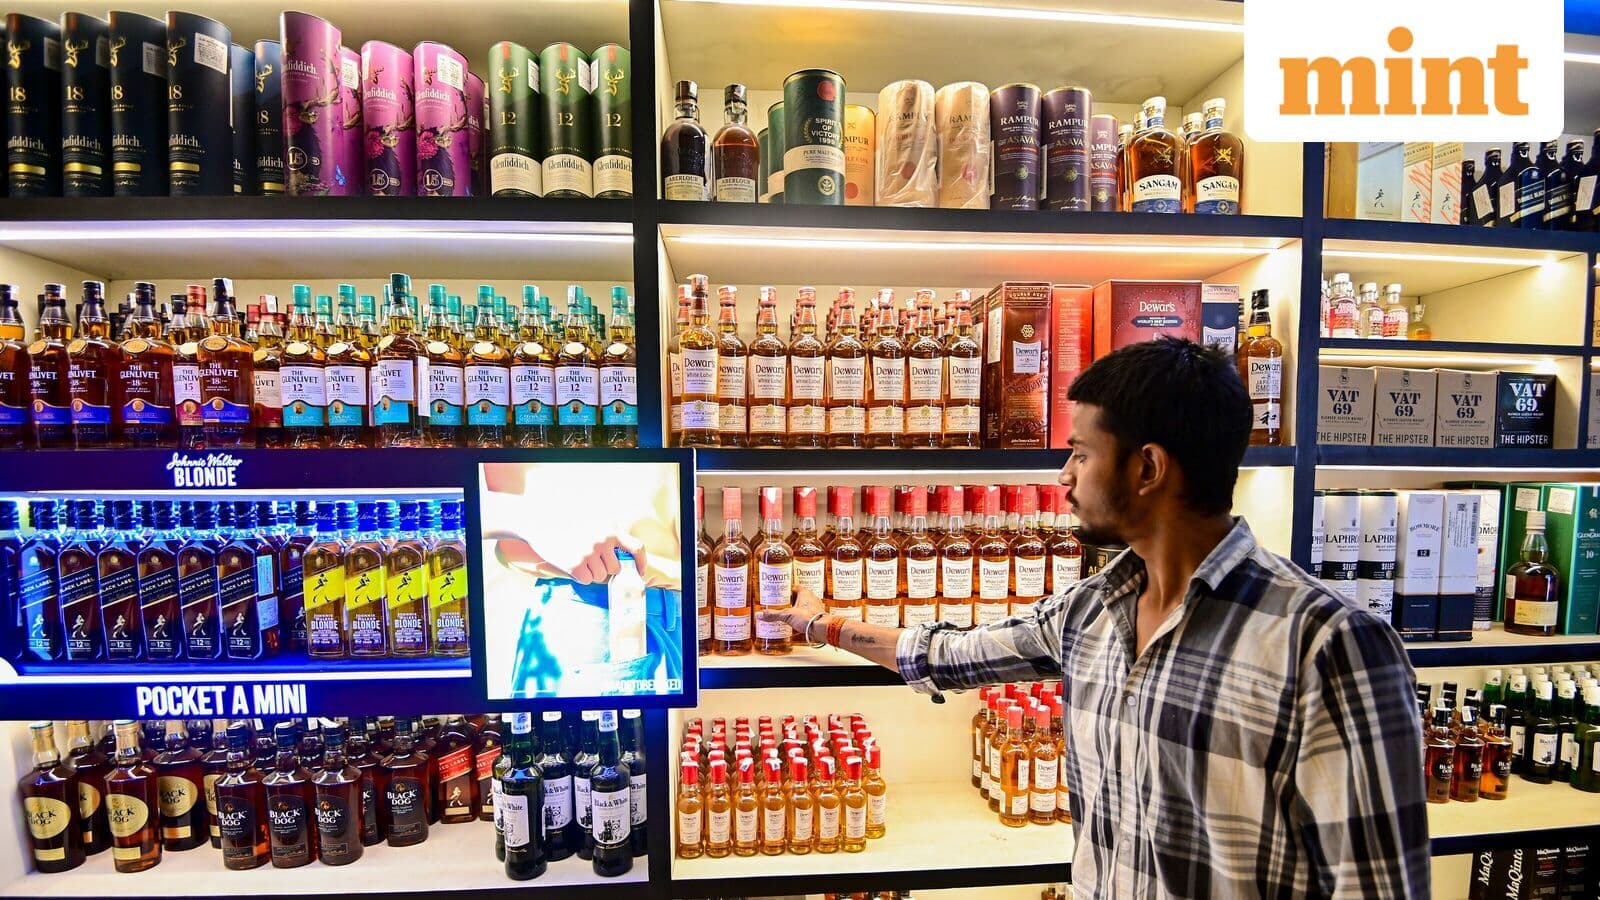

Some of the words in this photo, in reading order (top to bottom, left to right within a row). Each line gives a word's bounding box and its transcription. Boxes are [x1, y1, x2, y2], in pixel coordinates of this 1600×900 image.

[10, 86, 26, 102] 18
[66, 85, 84, 101] 18
[168, 84, 183, 100] 18
[500, 111, 517, 125] 12
[558, 112, 574, 127] 12
[606, 112, 622, 127] 12
[1000, 115, 1039, 127] RAMPUR
[1139, 178, 1178, 192] SANGAM
[1202, 179, 1238, 192] SANGAM
[1139, 300, 1176, 312] Dewar's
[120, 370, 160, 380] GLENLIVET
[199, 368, 239, 378] GLENLIVET
[282, 375, 318, 384] GLENLIVET
[467, 375, 503, 384] GLENLIVET
[515, 375, 551, 384] GLENLIVET
[558, 375, 593, 384] GLENLIVET
[602, 375, 637, 384] GLENLIVET
[184, 382, 194, 391] 15
[292, 383, 304, 392] 12
[331, 383, 341, 391] 12
[434, 382, 445, 391] 12
[479, 382, 489, 391] 12
[529, 382, 539, 391] 12
[570, 383, 580, 392] 12
[613, 383, 623, 392] 12
[1509, 383, 1547, 397] VAT
[1326, 389, 1360, 402] VAT
[1389, 392, 1421, 405] VAT
[1451, 394, 1482, 407] VAT
[1333, 403, 1352, 415] 69
[1515, 398, 1538, 412] 69
[1394, 405, 1414, 417] 69
[1456, 407, 1475, 419] 69
[1317, 431, 1332, 442] THE
[1333, 432, 1367, 443] HIPSTER
[1378, 433, 1393, 444] THE
[1395, 434, 1429, 444] HIPSTER
[1440, 435, 1455, 445] THE
[1457, 435, 1489, 446] HIPSTER
[1501, 434, 1516, 445] THE
[1516, 434, 1549, 445] HIPSTER
[167, 452, 206, 470] Johnnie
[208, 453, 243, 468] Walker
[174, 466, 237, 487] BLONDE
[1410, 523, 1440, 532] BOWMORE
[1585, 550, 1595, 559] 10
[35, 578, 53, 589] LABEL
[76, 577, 94, 588] LABEL
[116, 577, 135, 588] LABEL
[157, 578, 176, 588] LABEL
[196, 578, 214, 588] LABEL
[237, 578, 255, 588] LABEL
[311, 620, 338, 630] BLONDE
[353, 620, 381, 630] BLONDE
[394, 619, 422, 629] BLONDE
[437, 618, 464, 628] BLONDE
[136, 685, 226, 716] POCKET
[229, 686, 250, 715] A
[253, 684, 307, 715] MINI
[387, 790, 416, 800] BLACK
[391, 798, 412, 806] DOG
[218, 811, 246, 820] BLACK
[269, 809, 301, 818] BLACK
[314, 807, 342, 818] BLACK
[274, 817, 296, 825] DOG
[318, 816, 336, 824] DOG
[1505, 848, 1524, 900] MaQinto
